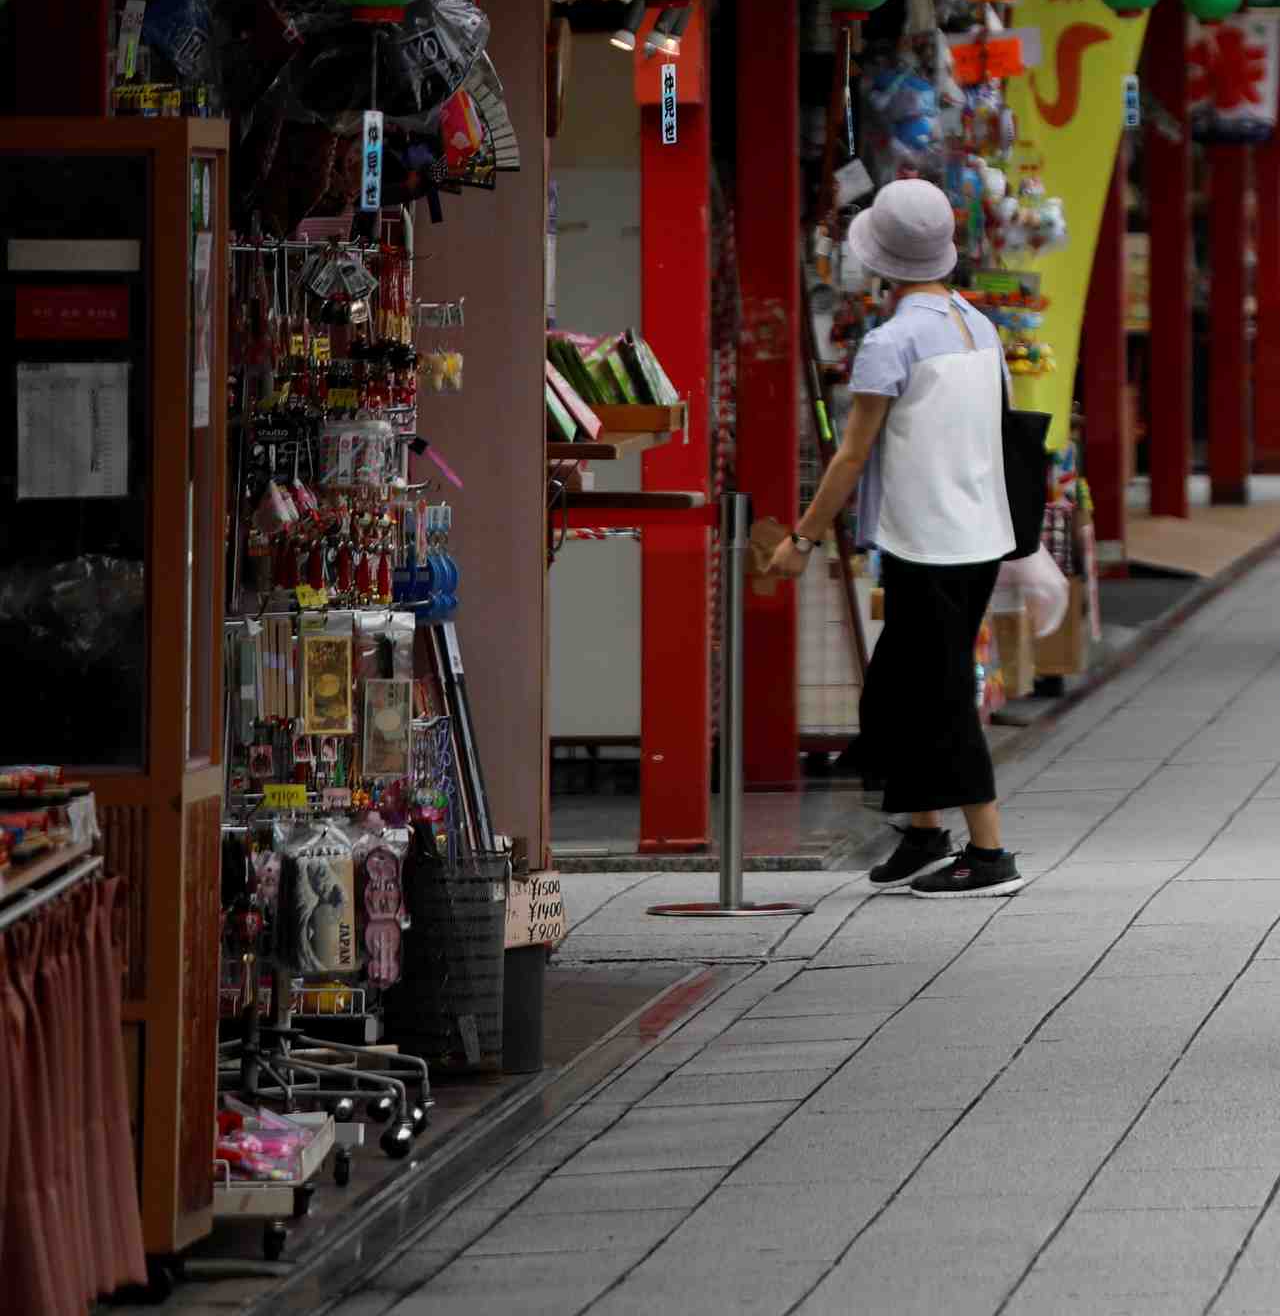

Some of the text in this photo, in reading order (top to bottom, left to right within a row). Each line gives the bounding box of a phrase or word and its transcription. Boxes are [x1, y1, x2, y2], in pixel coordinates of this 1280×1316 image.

[664, 73, 674, 141] 仲見世
[531, 877, 560, 900] ¥1500
[529, 901, 561, 922] ¥1400
[339, 923, 350, 964] JAPAN
[528, 923, 560, 942] ¥900
